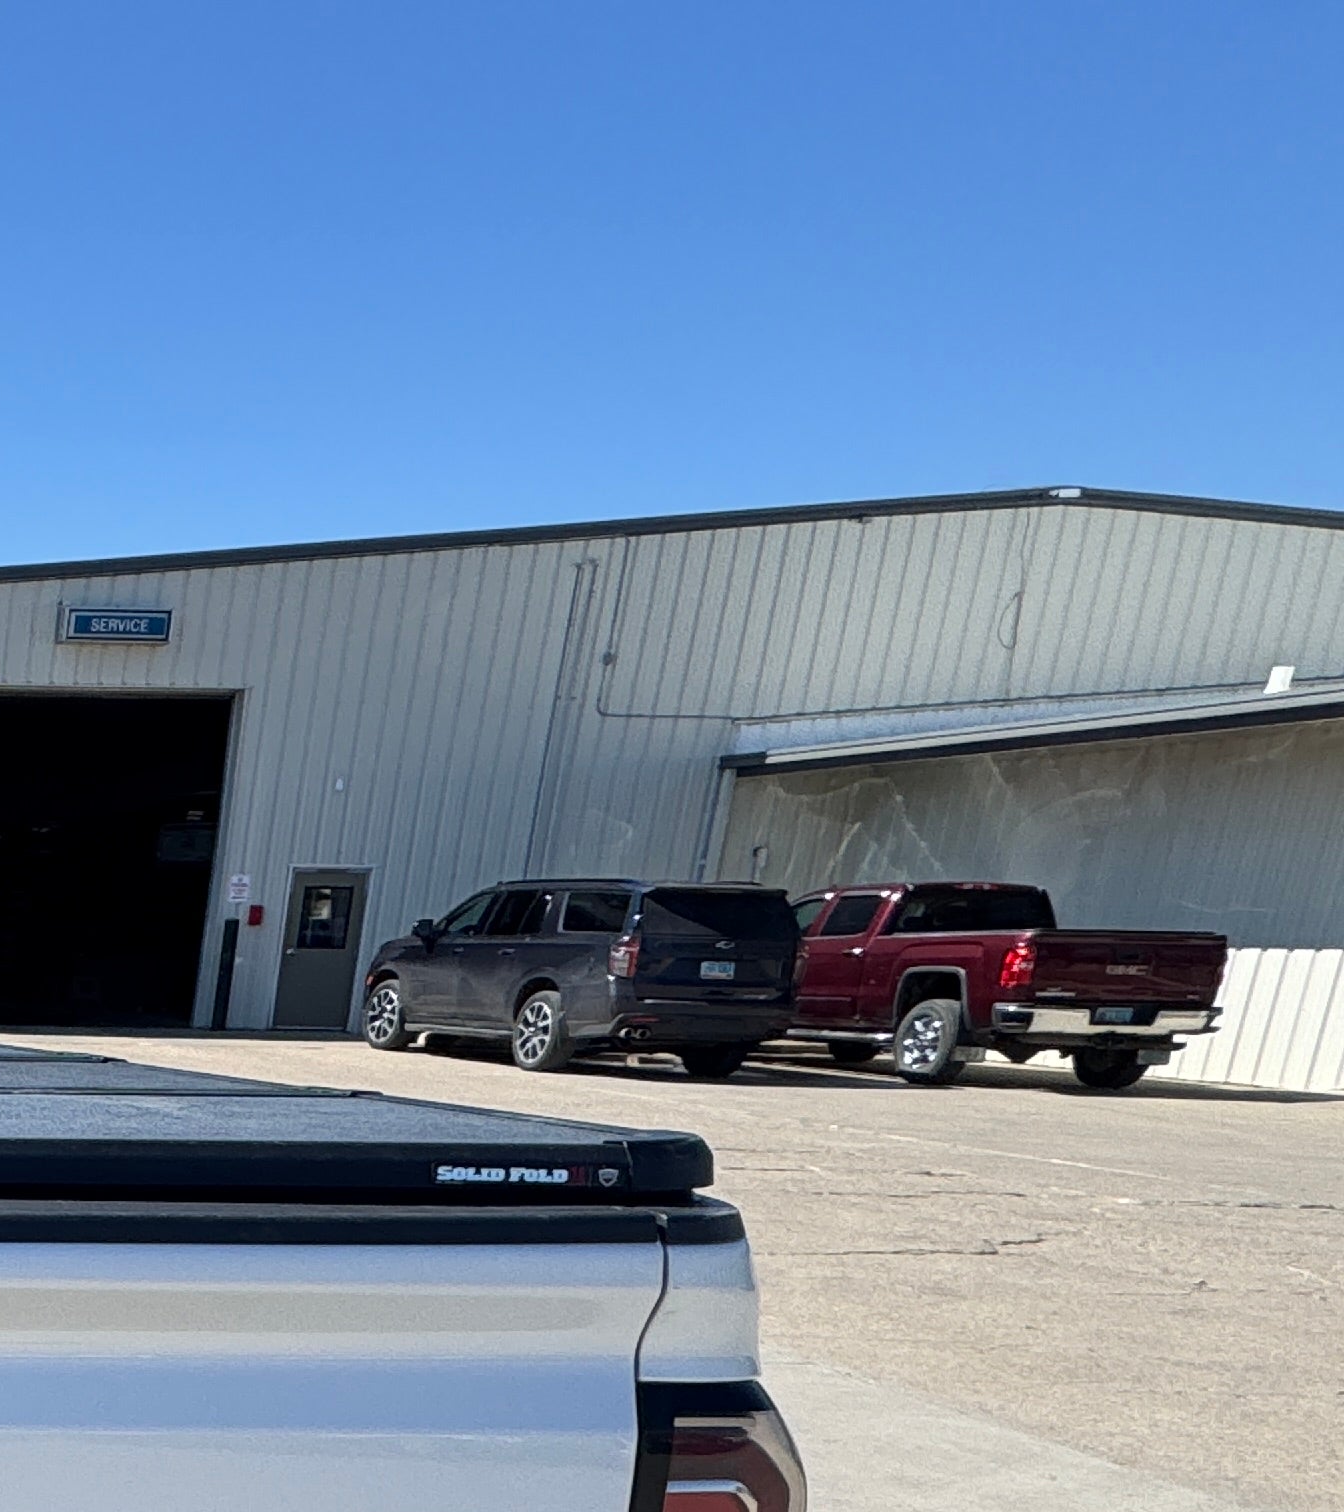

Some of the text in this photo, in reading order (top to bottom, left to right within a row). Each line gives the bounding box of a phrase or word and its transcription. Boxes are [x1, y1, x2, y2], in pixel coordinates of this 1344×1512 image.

[90, 618, 150, 632] SERVICE
[1105, 964, 1149, 976] GMC
[435, 1165, 506, 1182] SOLID
[508, 1166, 569, 1184] FOLD
